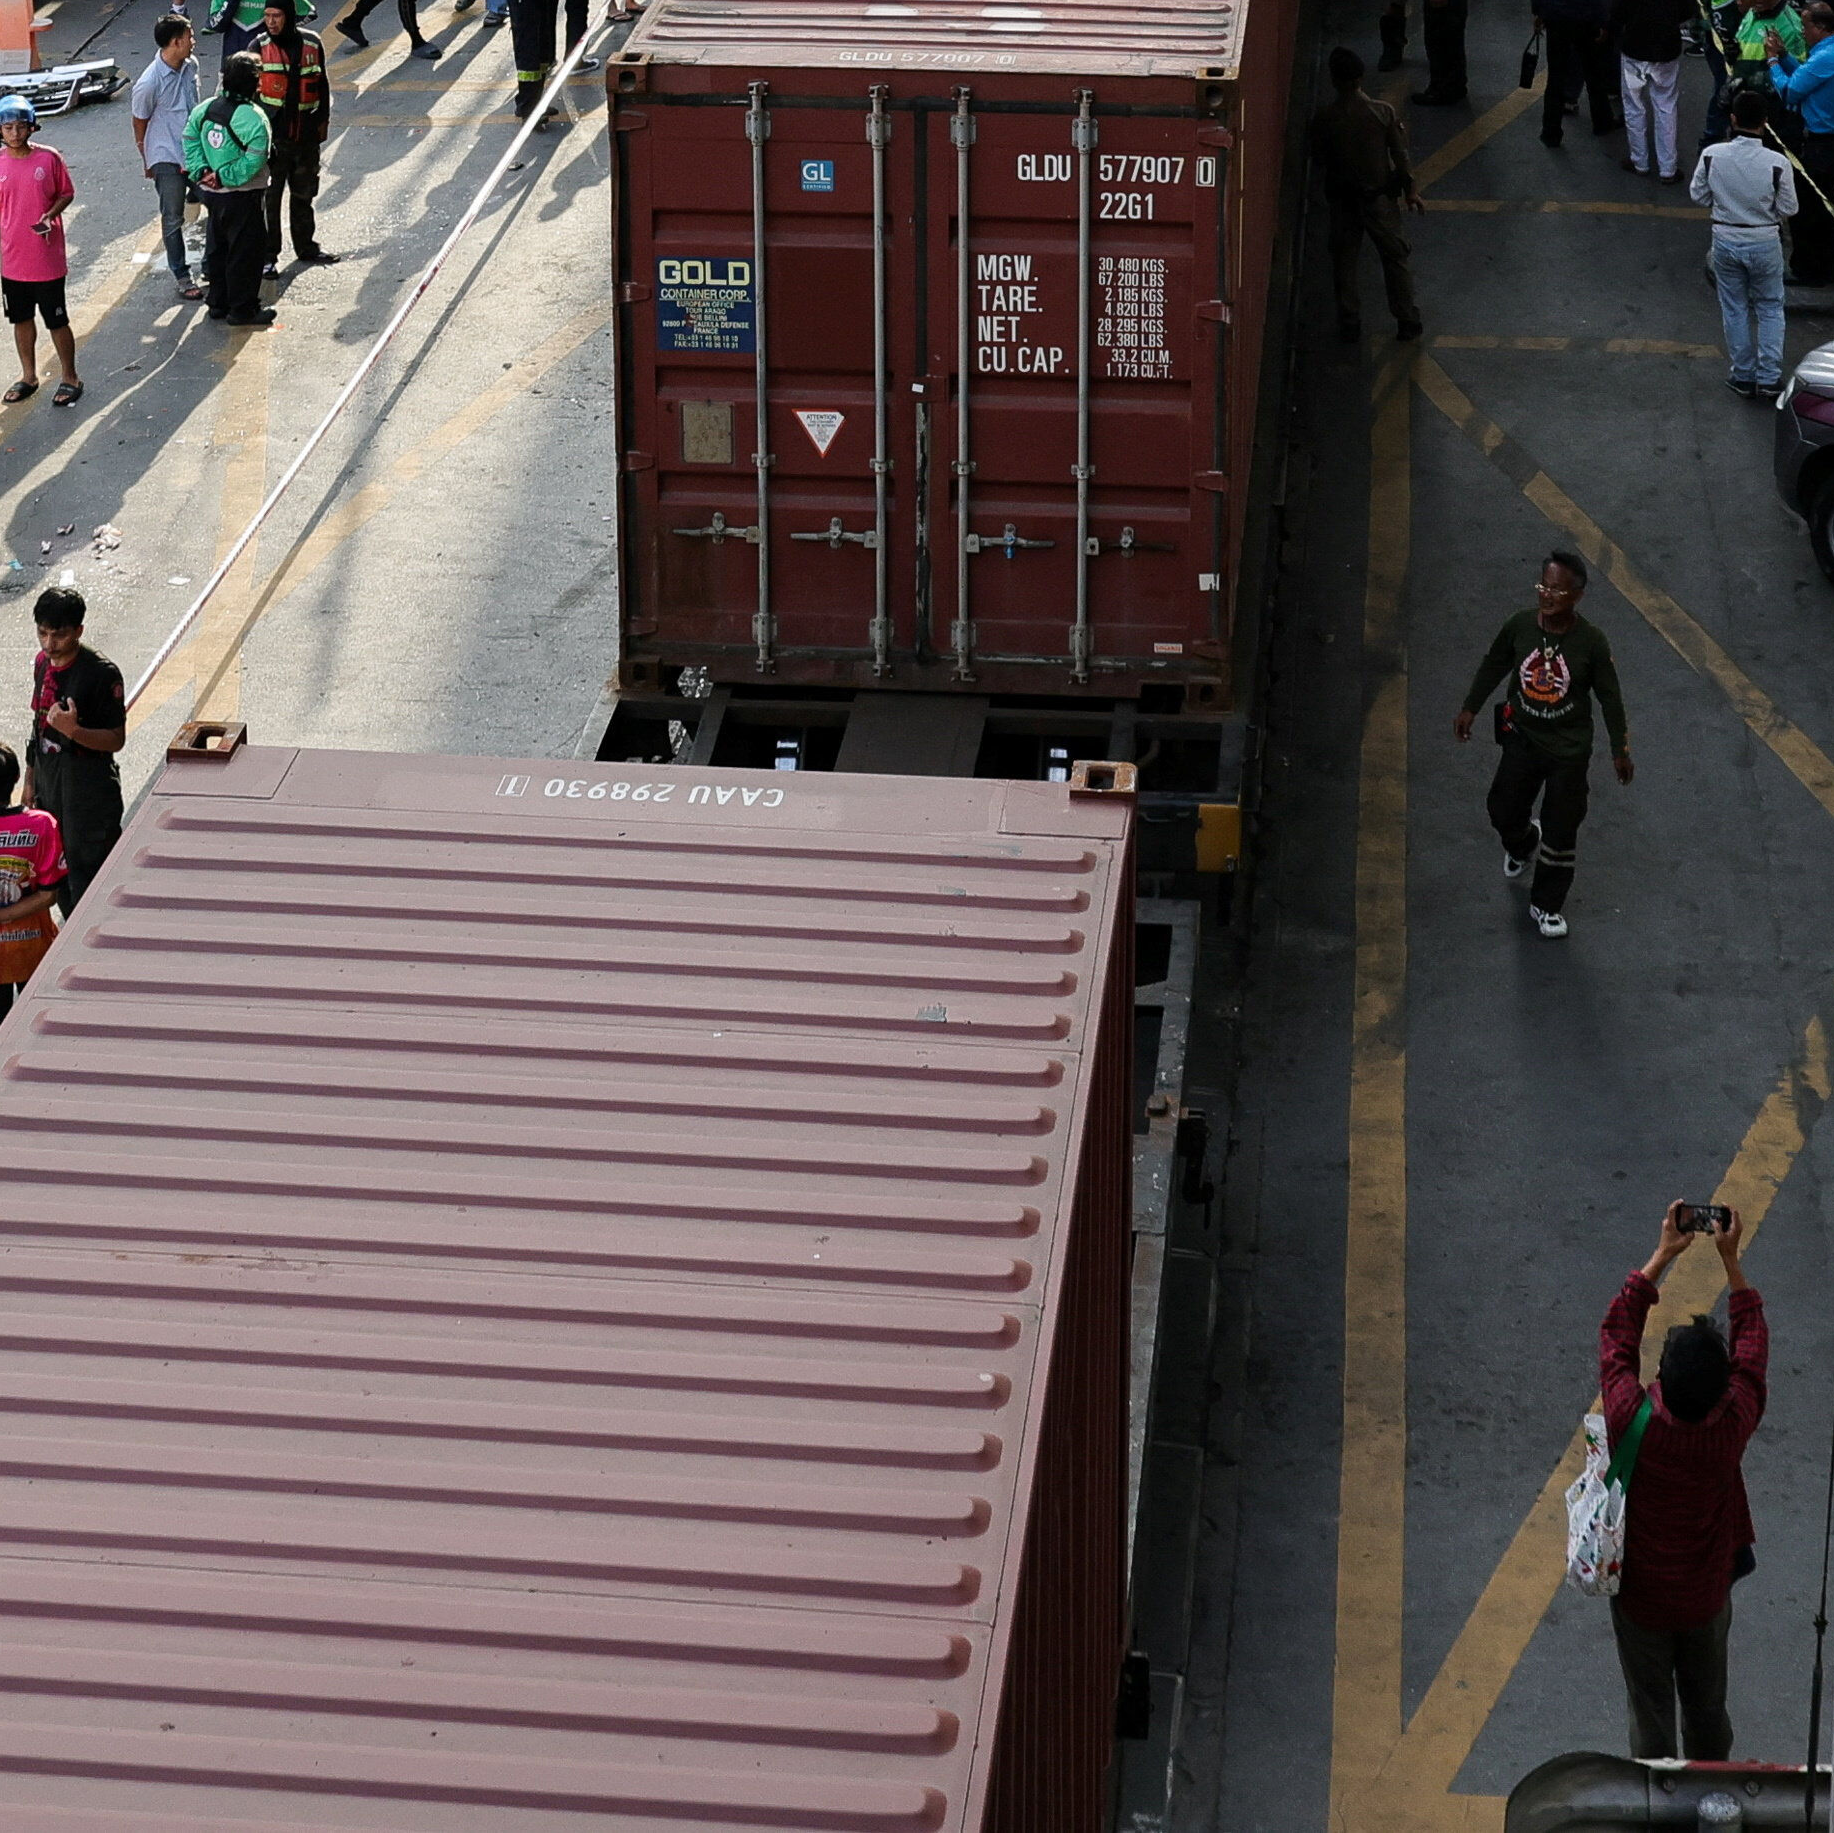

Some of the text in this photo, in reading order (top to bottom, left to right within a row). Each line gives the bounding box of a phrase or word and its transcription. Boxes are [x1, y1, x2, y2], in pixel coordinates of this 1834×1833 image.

[838, 52, 892, 62] GLDU
[900, 53, 984, 63] 577907
[802, 163, 832, 182] GL
[1017, 154, 1072, 182] GLDU
[1099, 155, 1187, 185] 577907
[1099, 192, 1155, 221] 22G1
[658, 259, 751, 287] GOLD
[976, 255, 1039, 282] MGW.
[1098, 257, 1169, 274] 30.480 KGS.
[1097, 273, 1165, 288] 67.200 LBS
[660, 288, 748, 302] CONTAINER CORP.
[977, 286, 1044, 313] TARE.
[1104, 288, 1168, 304] 2.185 KGS.
[1105, 302, 1164, 318] 4.820 LBS
[977, 316, 1028, 343] NET.
[1098, 318, 1169, 334] 28.295 KGS.
[1097, 333, 1165, 349] 62.380 LBS
[976, 347, 1070, 374] CU.CAP.
[1111, 349, 1174, 364] 33.2 CU.M.
[1106, 363, 1138, 378] 1.173
[542, 777, 671, 802] 298930
[686, 786, 785, 808] CAAU
